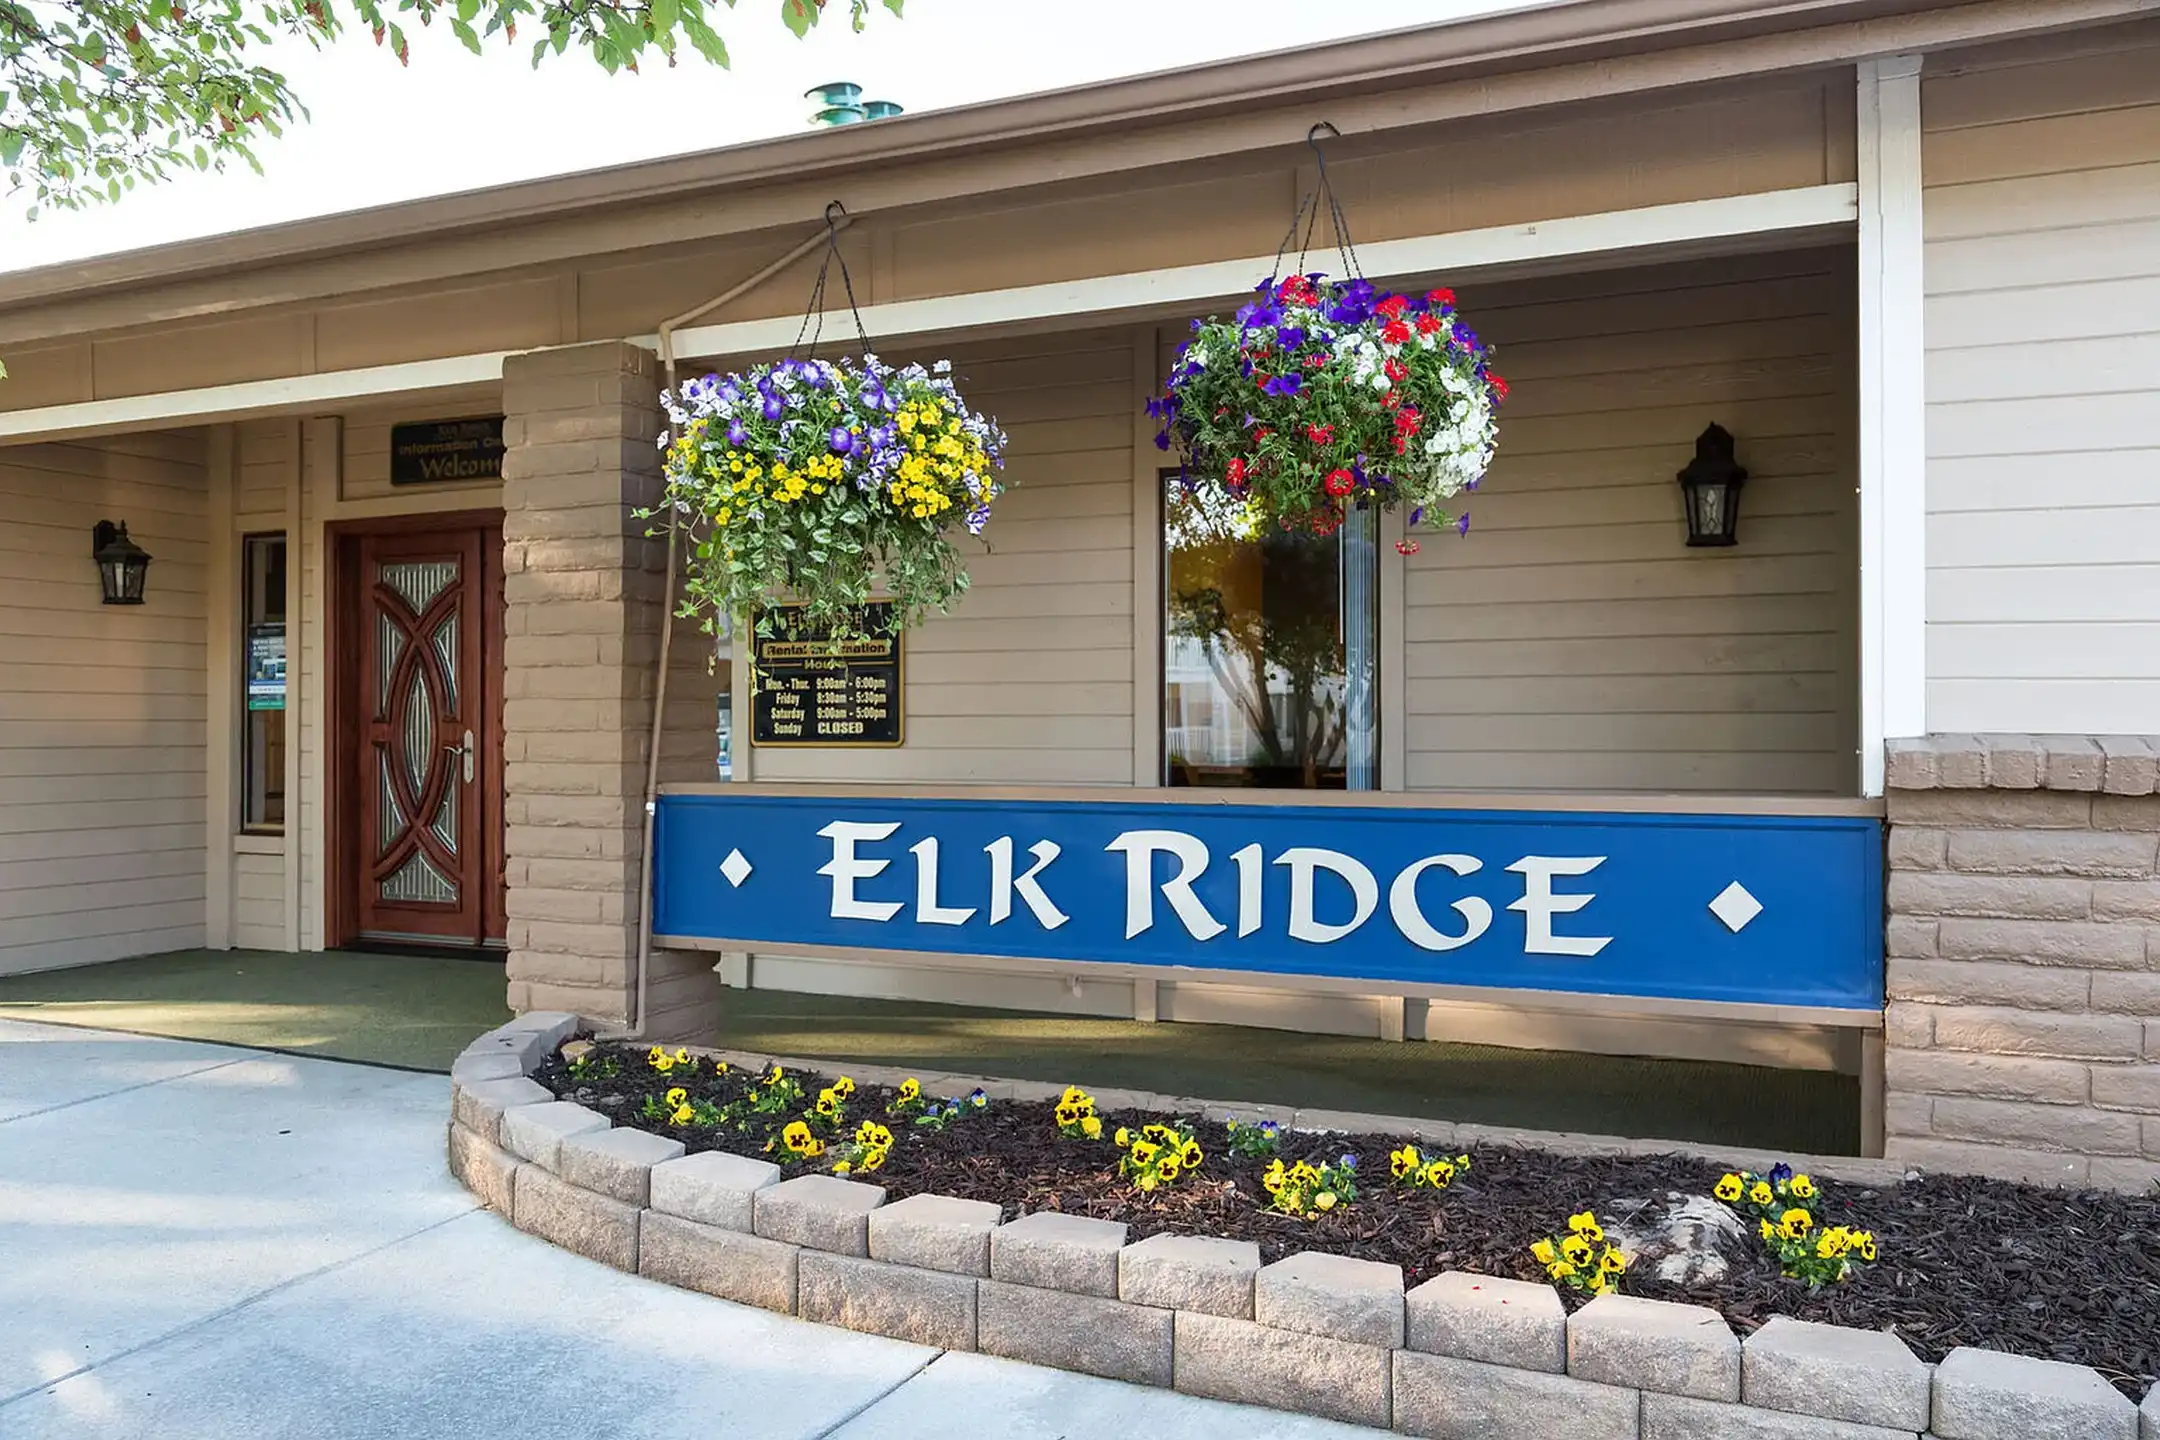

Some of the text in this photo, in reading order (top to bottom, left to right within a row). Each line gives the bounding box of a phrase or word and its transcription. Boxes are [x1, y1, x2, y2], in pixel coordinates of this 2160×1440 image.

[418, 451, 501, 479] Welcom
[766, 642, 886, 656] Rental Infmation
[804, 659, 847, 670] Hous
[765, 677, 785, 690] Mon.
[815, 676, 846, 690] 9:00am
[855, 676, 886, 691] 6:00pm
[775, 692, 801, 707] Friday
[855, 691, 887, 706] 5:30pm
[770, 707, 806, 722] Saturday
[816, 706, 847, 720] 9:00am
[855, 706, 887, 721] 5:00pm
[773, 721, 864, 737] Sunday CLOSED
[815, 820, 1615, 957] ELK RIDGE
